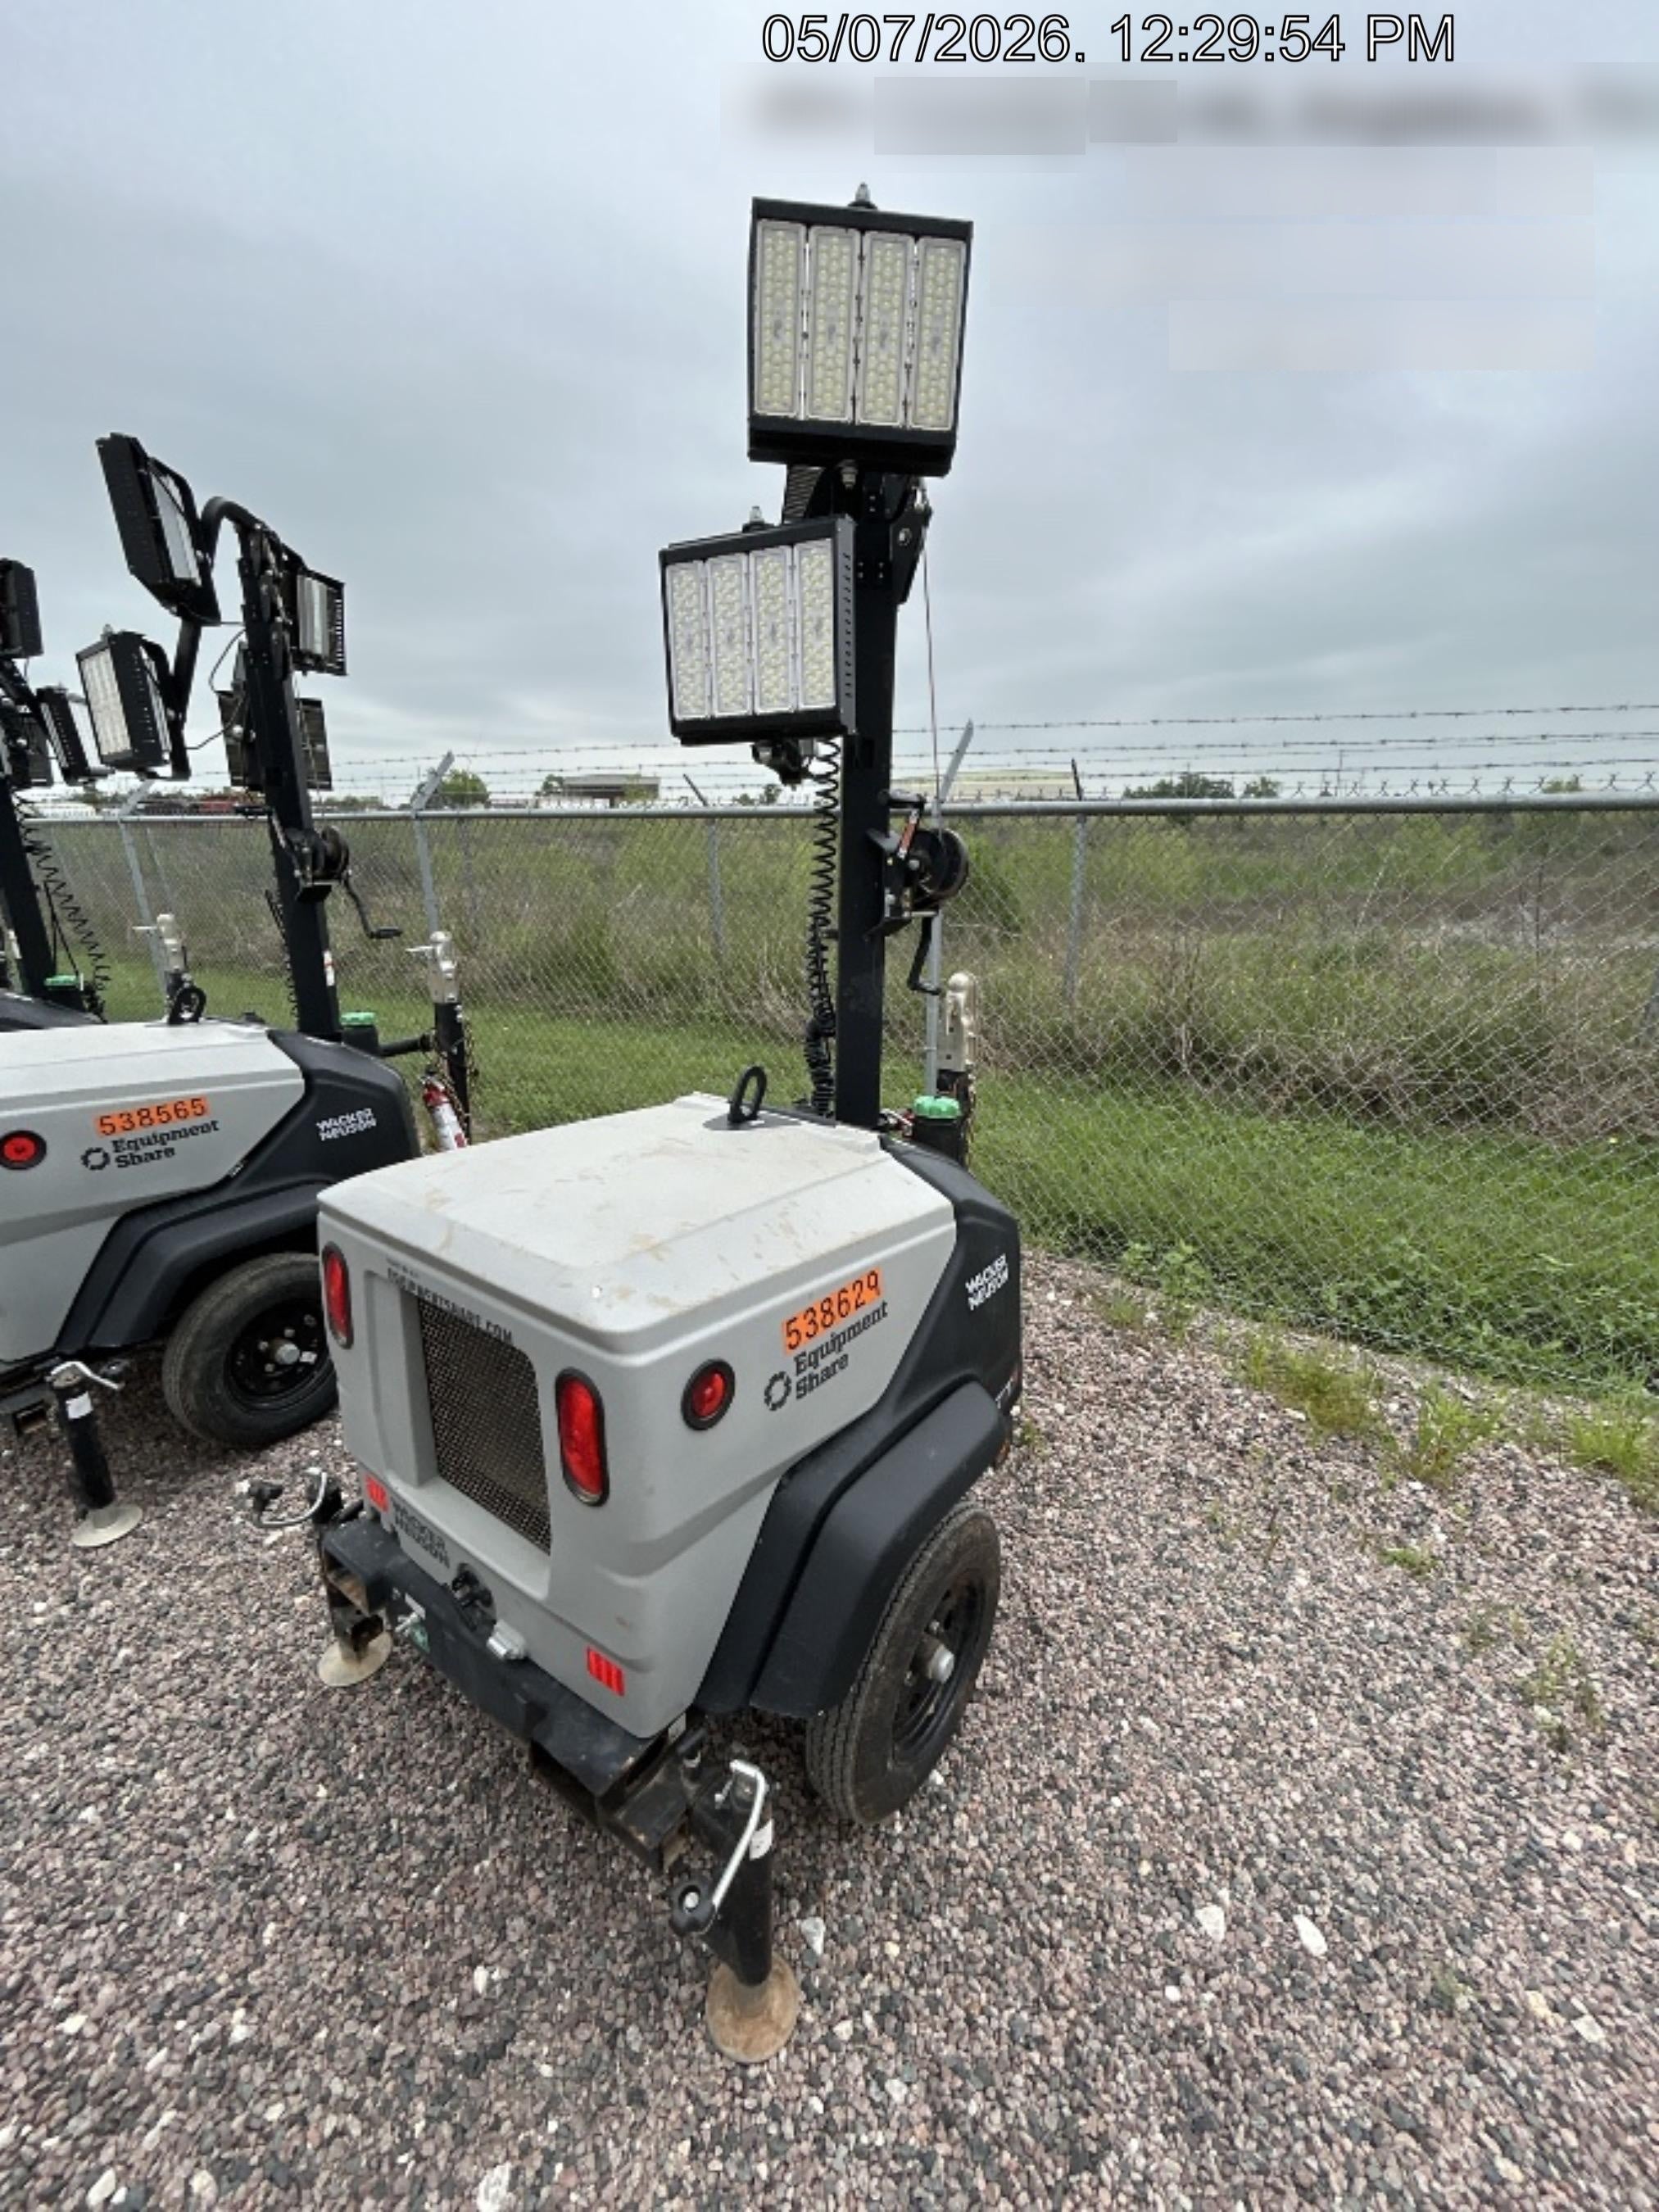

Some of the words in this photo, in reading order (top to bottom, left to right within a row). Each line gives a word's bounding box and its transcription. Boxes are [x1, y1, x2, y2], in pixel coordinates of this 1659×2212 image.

[99, 1098, 206, 1135] 538565
[315, 1108, 372, 1131] WACKER
[111, 1120, 220, 1153] Equipment
[115, 1147, 175, 1167] Share
[965, 1253, 1006, 1294] WACKER
[786, 1270, 880, 1350] 538629
[794, 1301, 887, 1376] Equipment
[796, 1353, 849, 1399] Share
